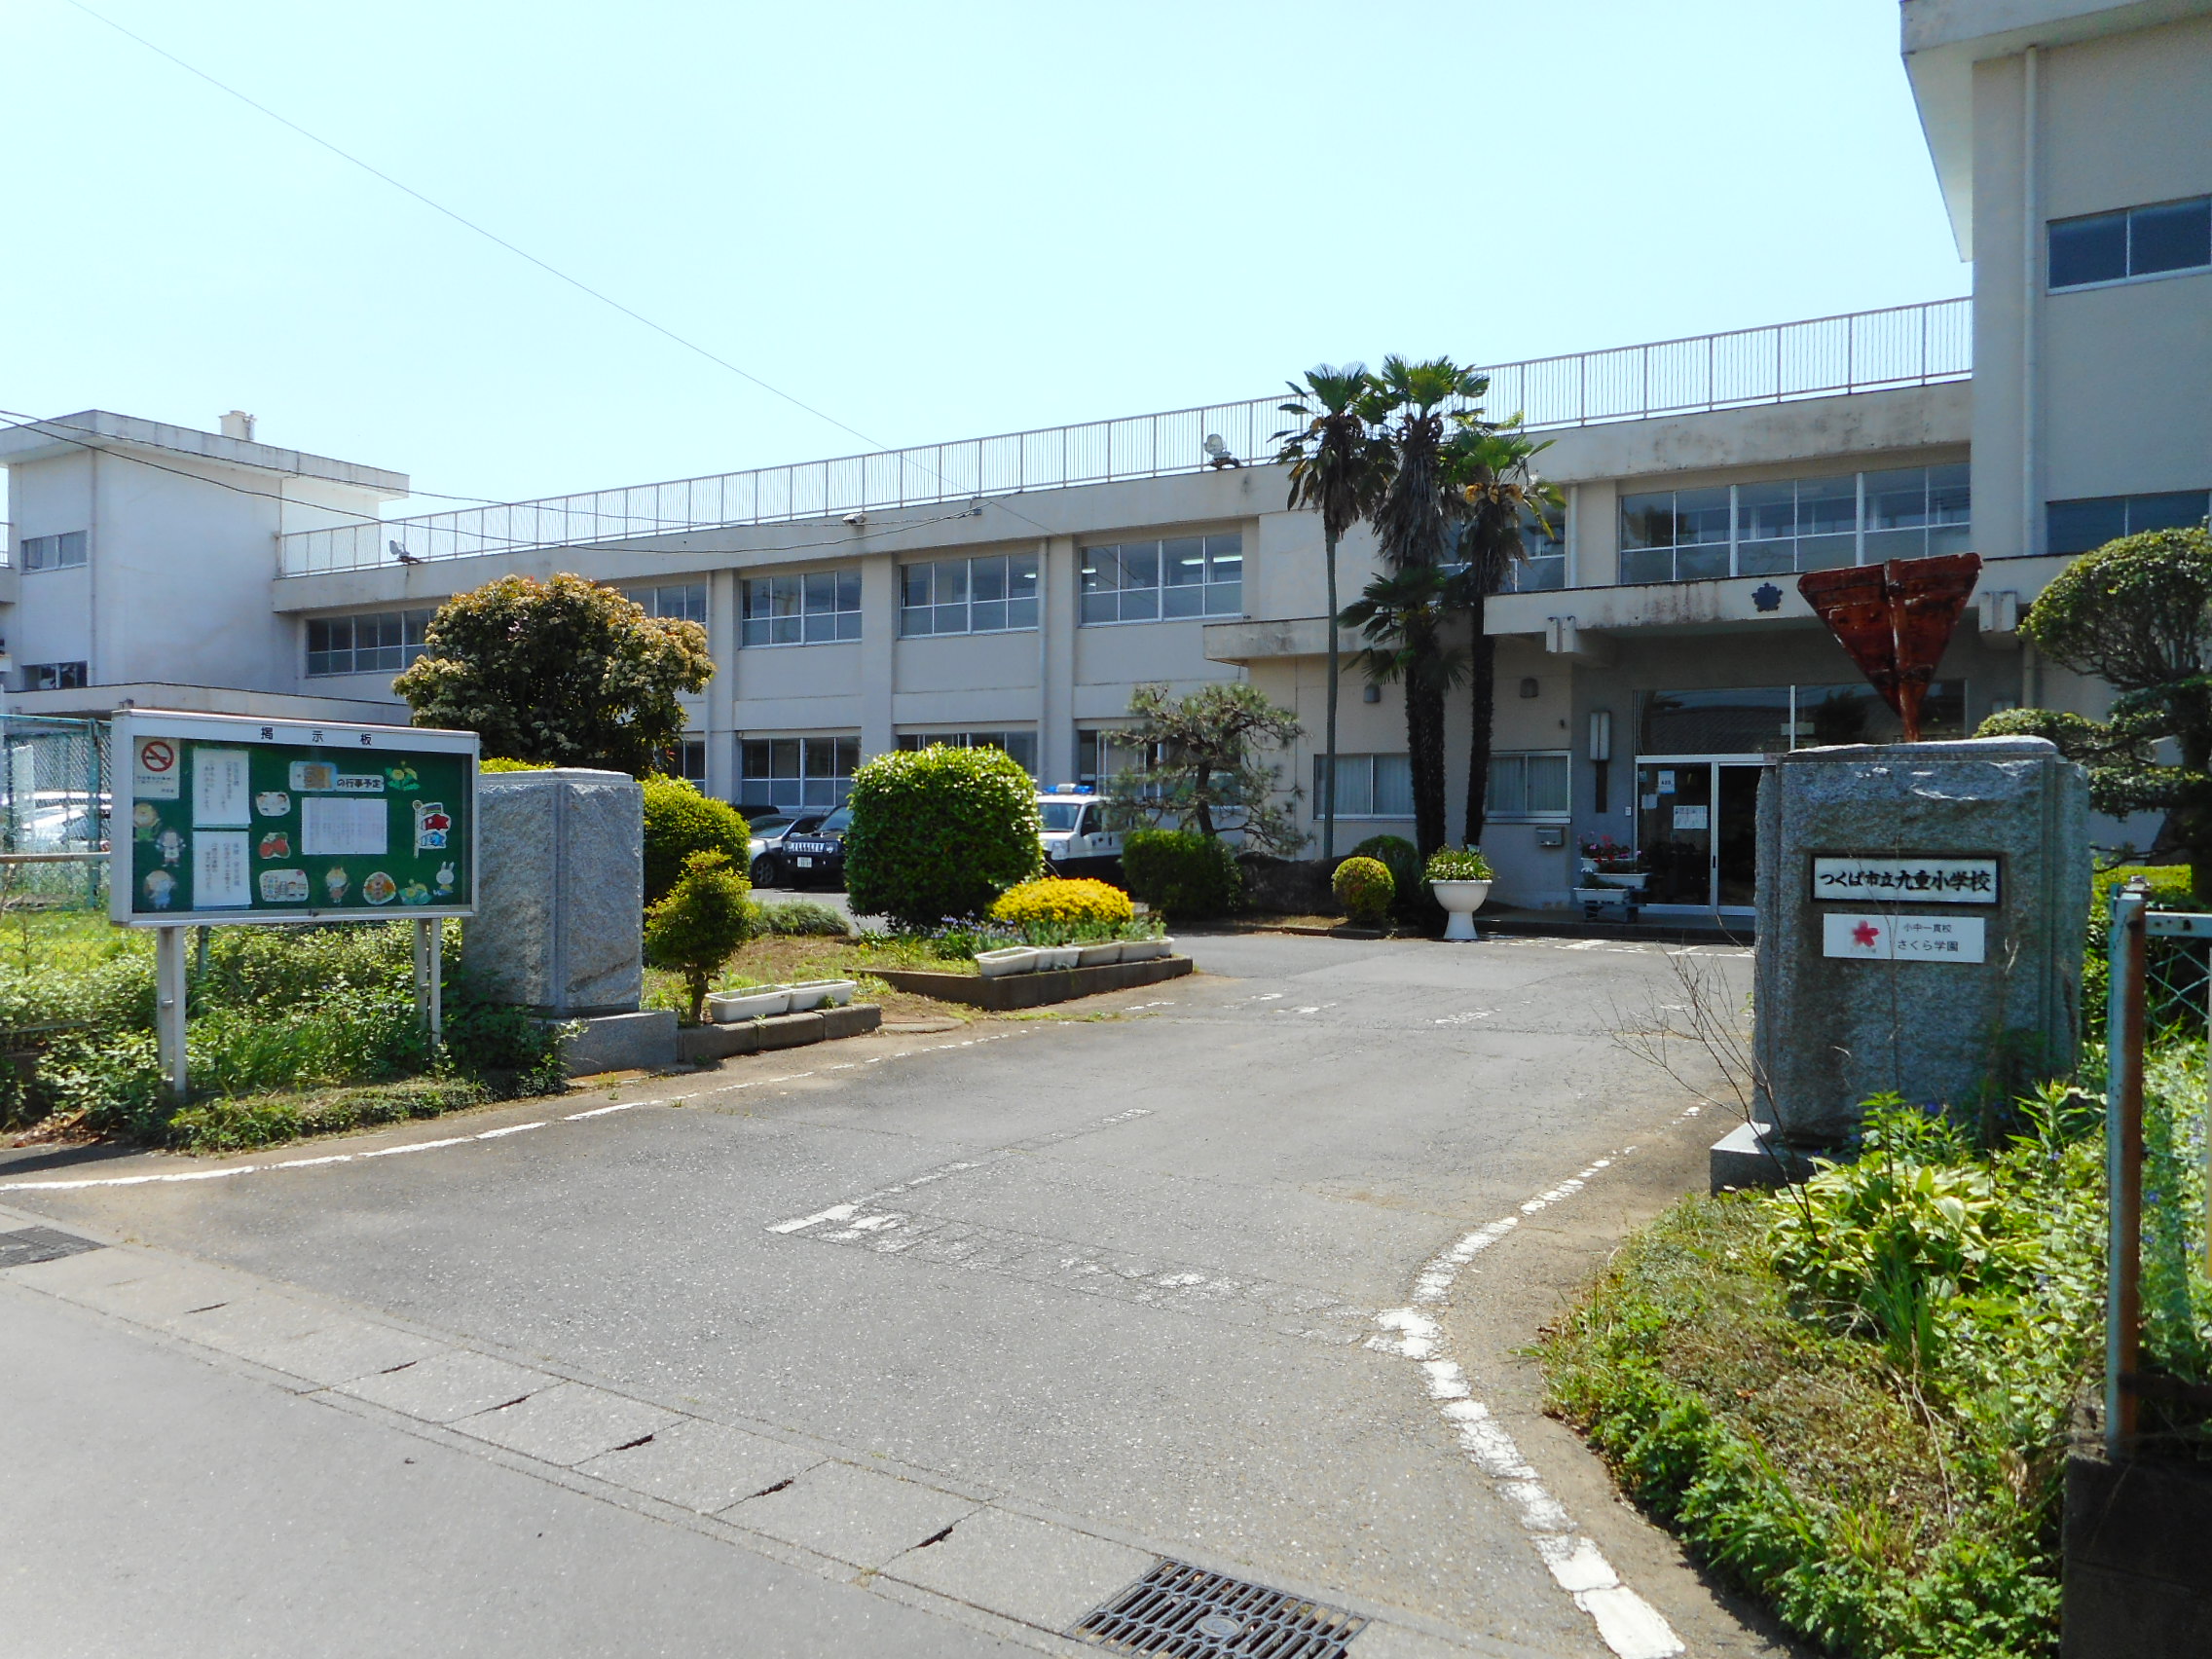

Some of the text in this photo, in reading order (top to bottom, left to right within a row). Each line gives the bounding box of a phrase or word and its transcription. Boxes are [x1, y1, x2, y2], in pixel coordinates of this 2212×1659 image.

[261, 726, 372, 746] 掲示板
[337, 778, 382, 789] の行事予定
[1819, 869, 1992, 892] つくば市立九重小学校
[1903, 923, 1952, 934] 小中一貫校
[1898, 940, 1959, 952] さくら学園
